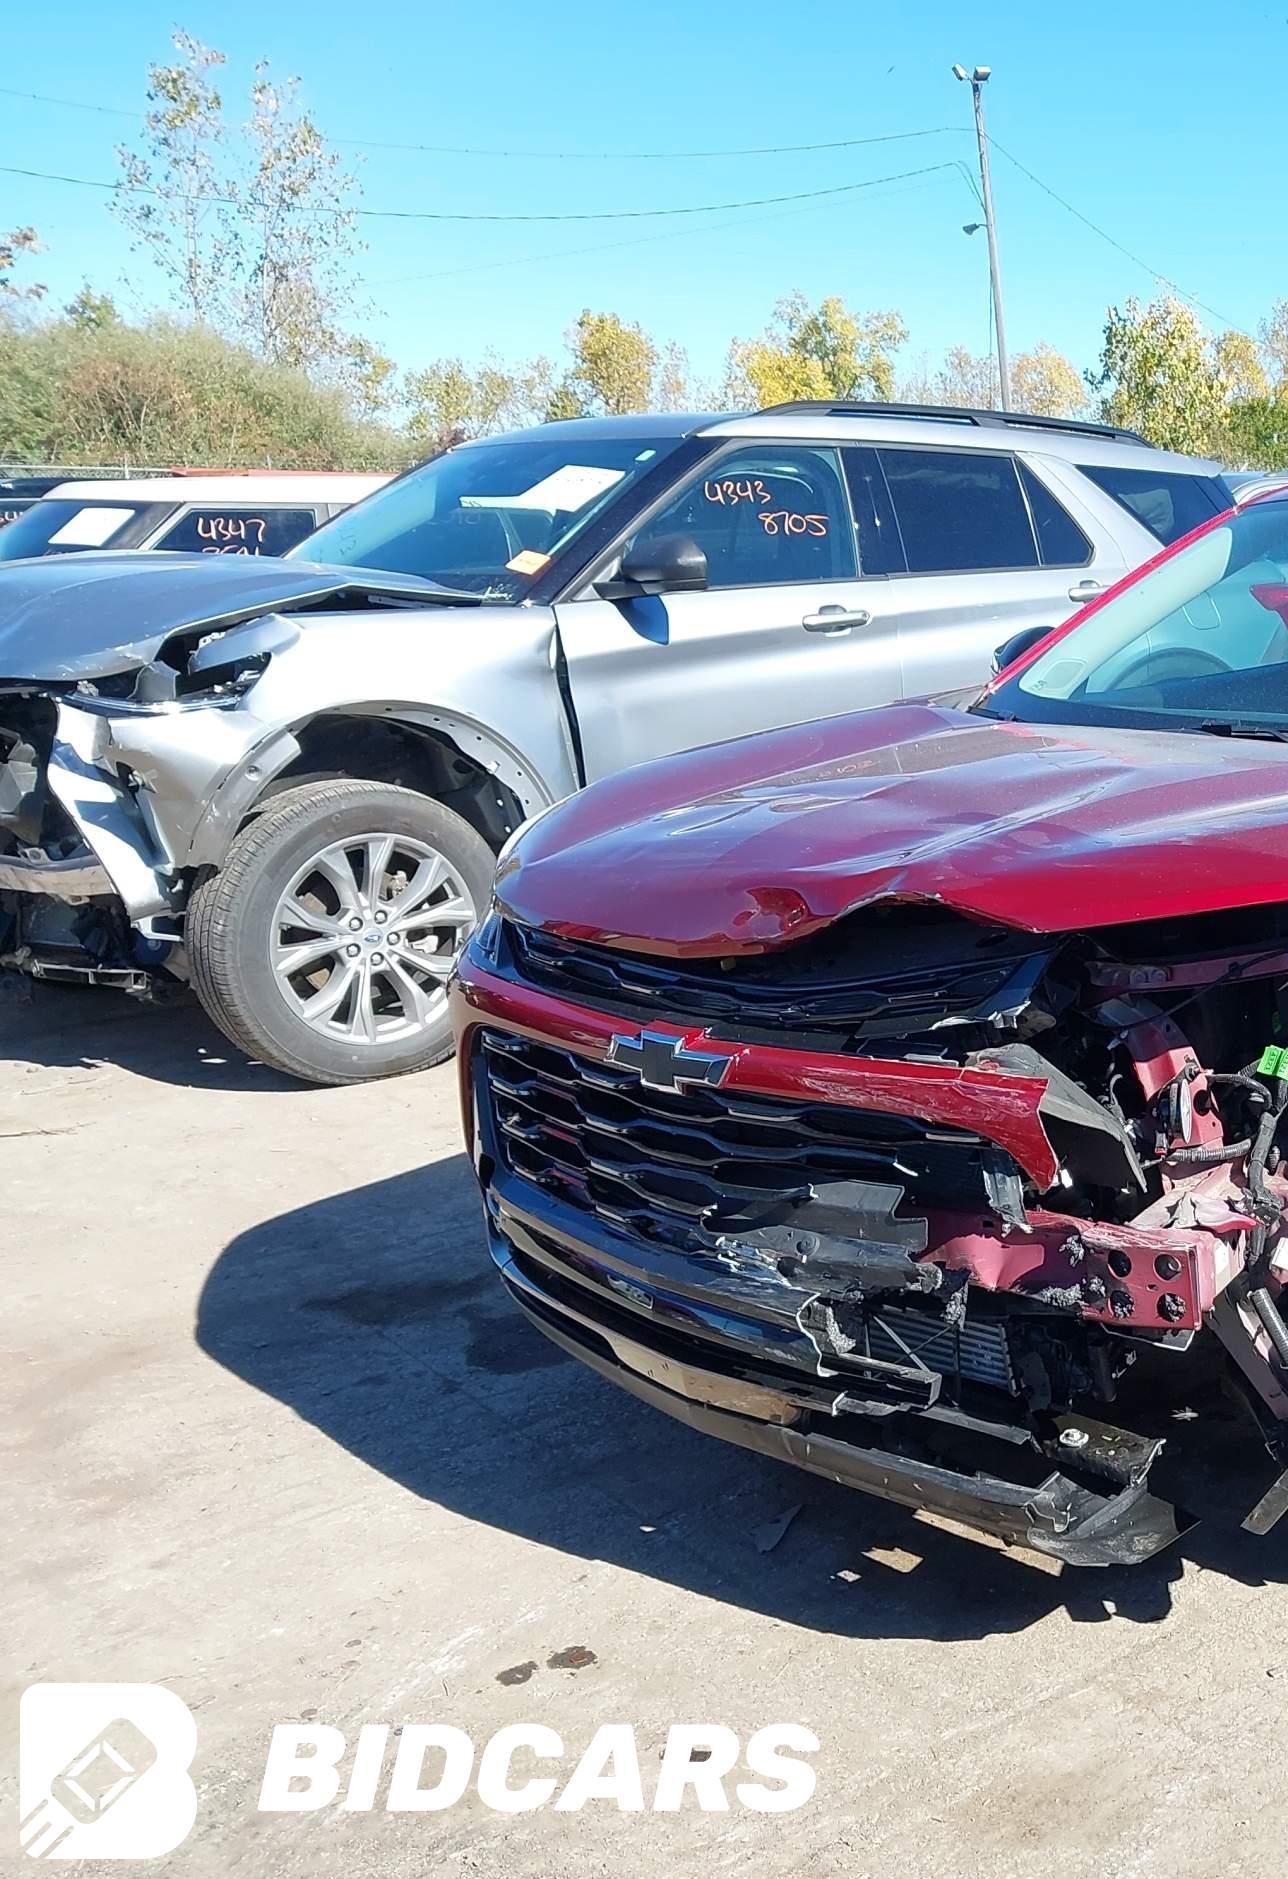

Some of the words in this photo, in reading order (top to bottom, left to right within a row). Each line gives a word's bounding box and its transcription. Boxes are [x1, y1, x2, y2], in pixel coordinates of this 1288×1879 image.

[704, 479, 772, 506] 4343
[197, 517, 266, 542] 4347
[757, 510, 830, 537] 8705
